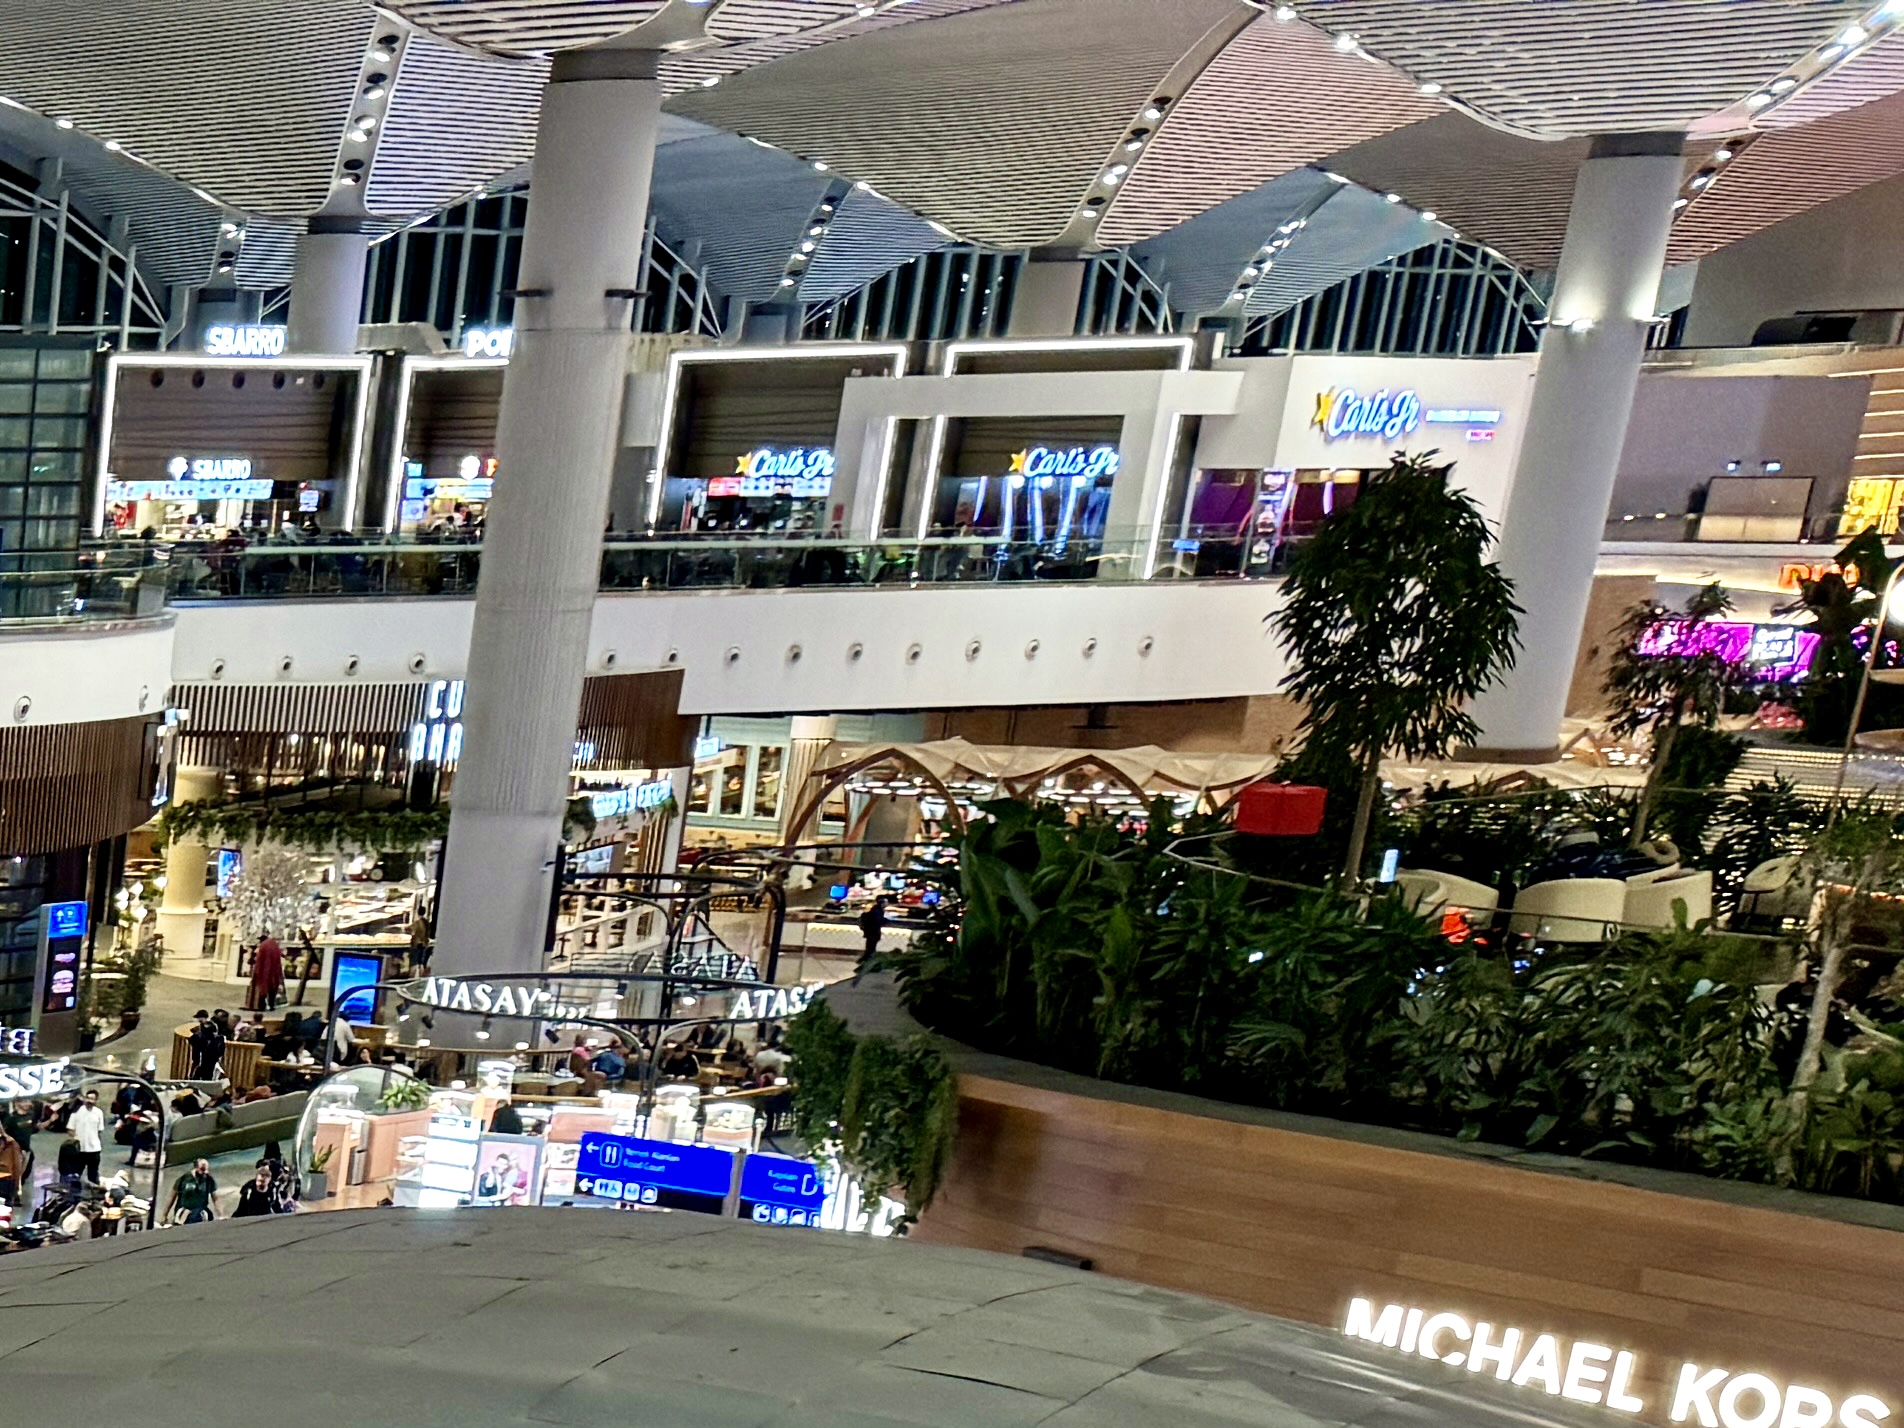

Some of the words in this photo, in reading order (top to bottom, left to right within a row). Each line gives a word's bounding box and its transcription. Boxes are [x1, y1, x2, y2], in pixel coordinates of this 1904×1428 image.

[207, 327, 286, 355] SBARRO
[421, 977, 541, 1017] ATASAY
[1343, 1296, 1645, 1414] MICHAEL
